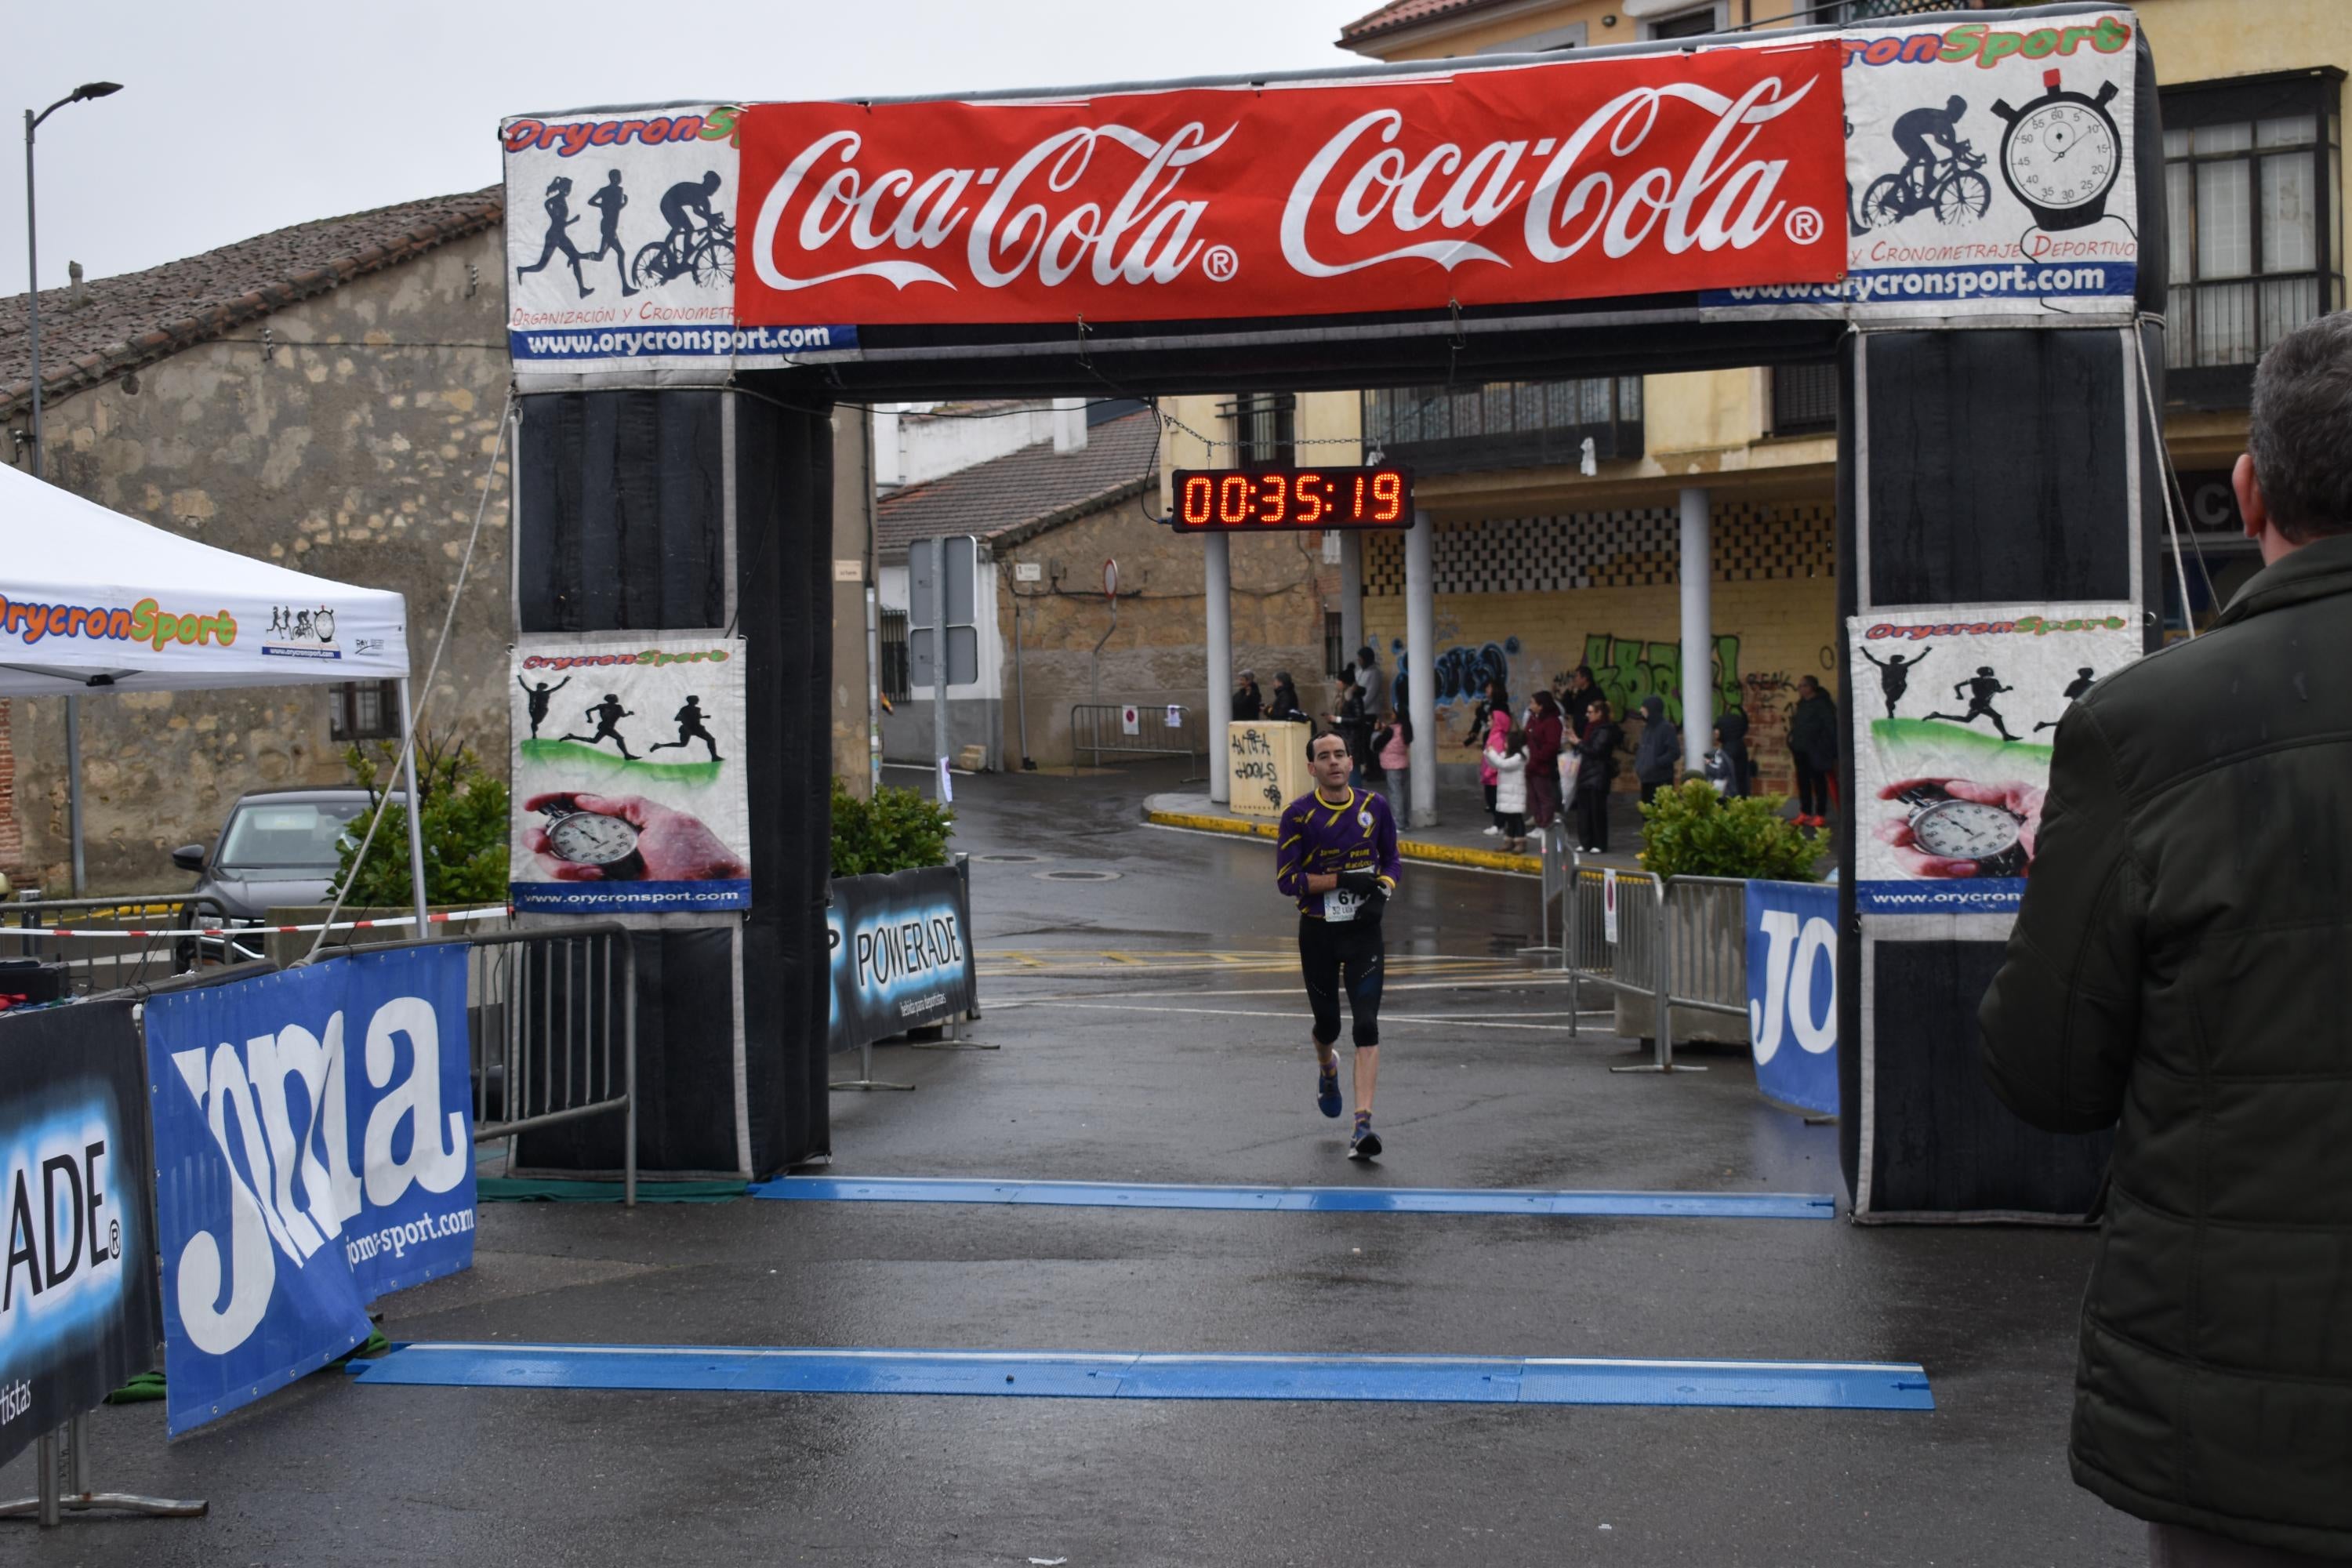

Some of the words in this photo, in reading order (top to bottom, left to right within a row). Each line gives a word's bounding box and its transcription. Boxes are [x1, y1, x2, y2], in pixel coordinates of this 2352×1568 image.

[1842, 16, 2131, 69] ronSport
[2051, 110, 2063, 120] 60
[2074, 113, 2080, 122] 5
[506, 106, 741, 158] OrycronS
[2032, 120, 2045, 129] 55
[2088, 125, 2099, 133] 10
[2021, 135, 2033, 143] 50
[2097, 144, 2107, 153] 15
[1279, 74, 1820, 278] Coca-Cola
[2026, 175, 2038, 183] 40
[2092, 165, 2104, 175] 20
[2042, 187, 2054, 197] 35
[2081, 180, 2093, 190] 25
[2062, 190, 2074, 199] 30
[753, 121, 1239, 291] Coca-Cola
[2033, 235, 2136, 259] DEPORTIVO
[1730, 266, 2105, 300] www.orycronsport.com
[640, 301, 735, 321] CRONOMETR
[528, 326, 830, 354] www.orycronsport.com
[1184, 474, 1401, 524] 00:35:19
[1867, 615, 2126, 641] OrycronSport
[523, 649, 730, 671] OrycronSport
[525, 891, 739, 904] www.orycronsport.com
[1338, 890, 1357, 906] 67
[1872, 892, 2023, 904] www.orycron
[857, 916, 960, 986] POWERADE
[1751, 909, 1838, 1065] JO
[346, 1208, 475, 1273] jom-sport.com
